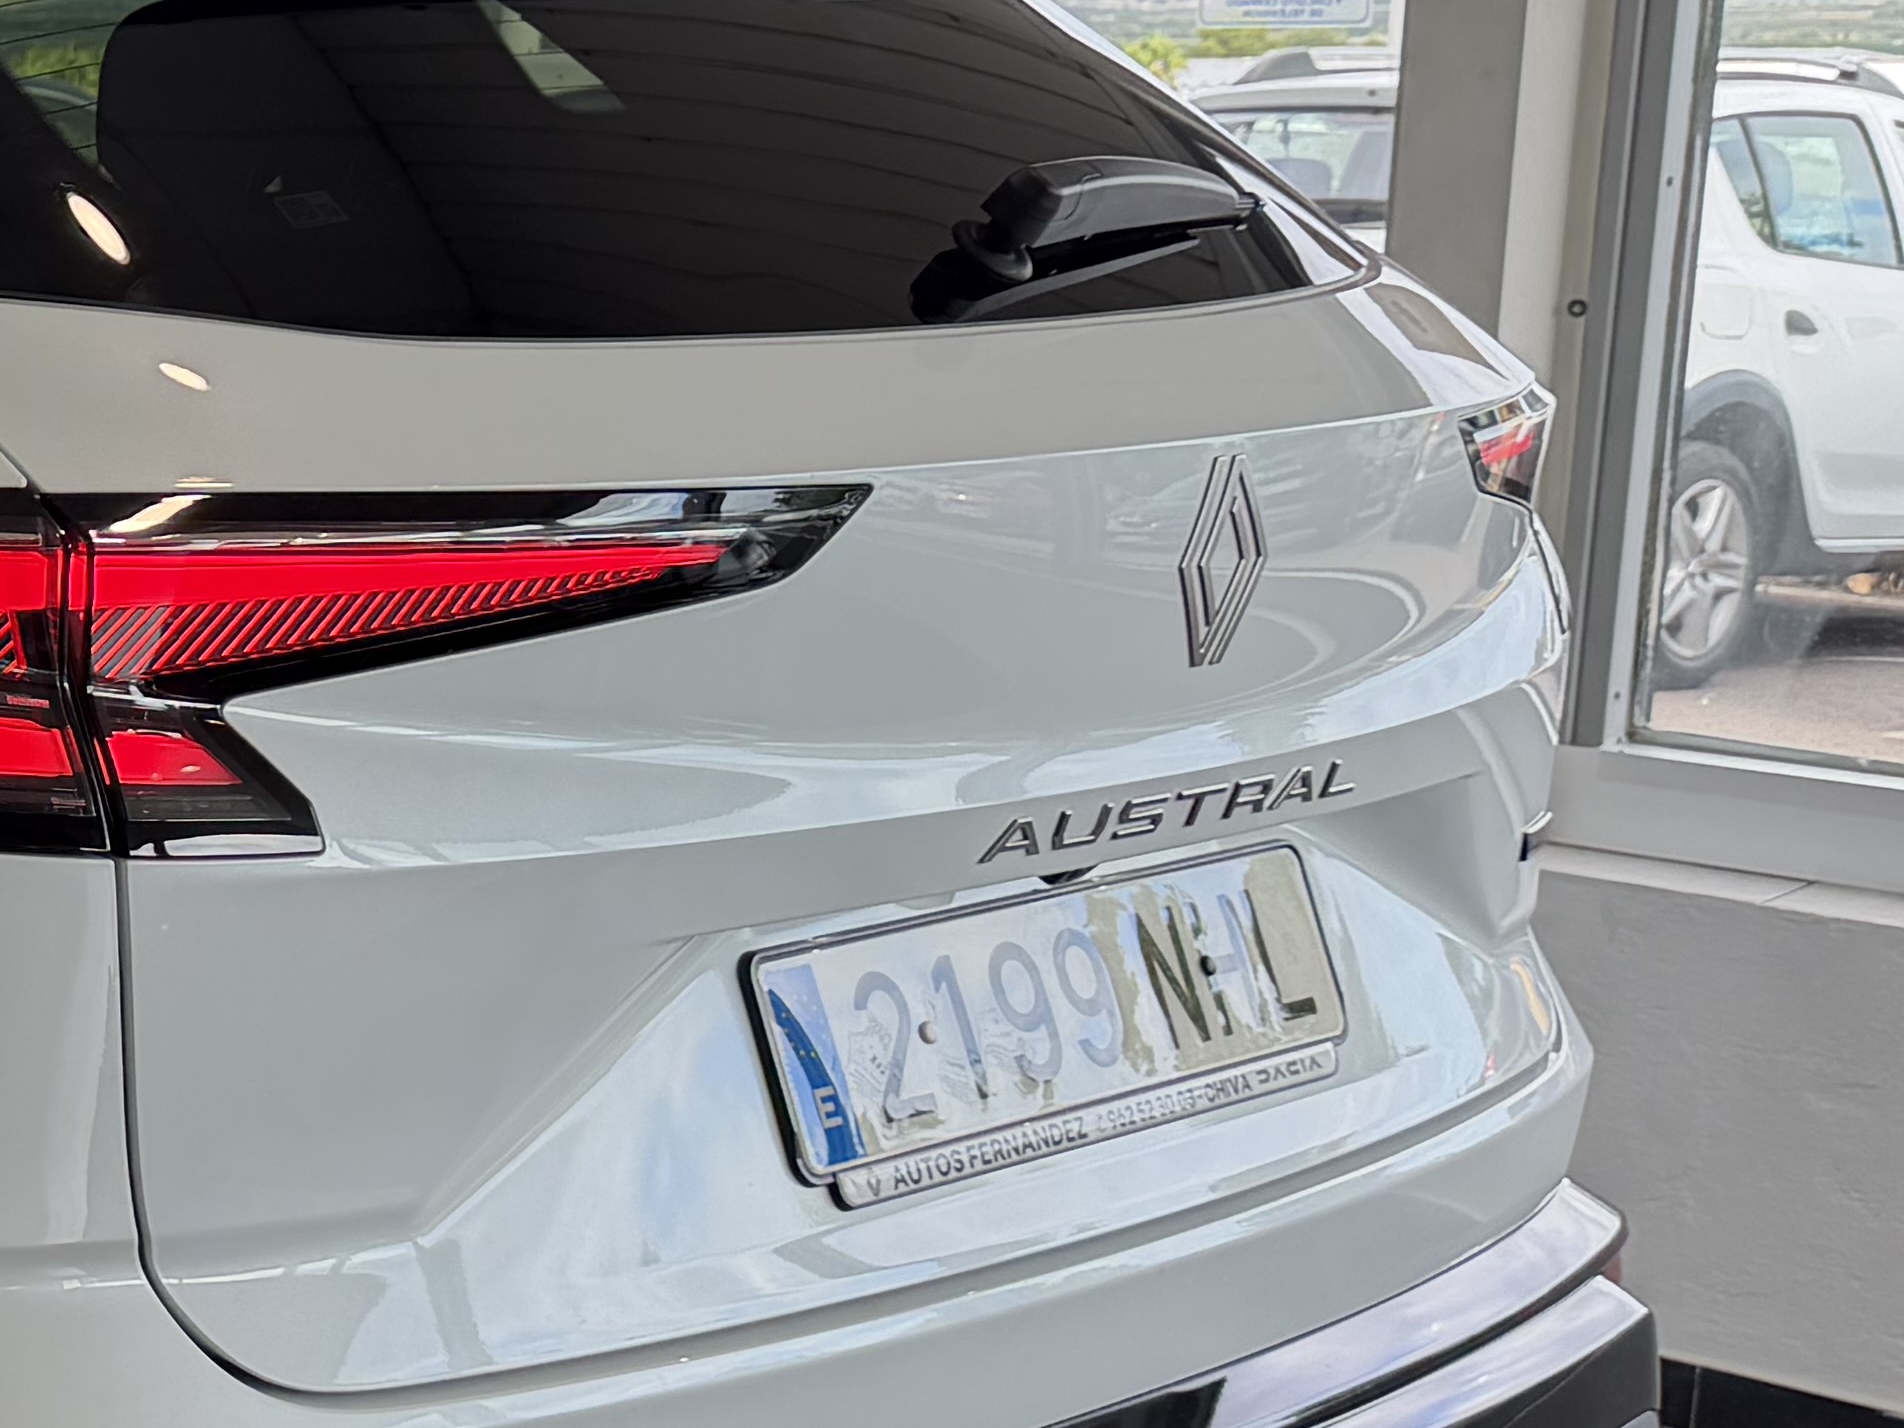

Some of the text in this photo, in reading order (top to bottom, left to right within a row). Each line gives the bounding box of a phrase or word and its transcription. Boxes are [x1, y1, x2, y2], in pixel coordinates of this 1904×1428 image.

[977, 759, 1356, 866] AUSTRAL
[814, 1085, 843, 1130] E
[893, 1149, 966, 1190] AUTOS
